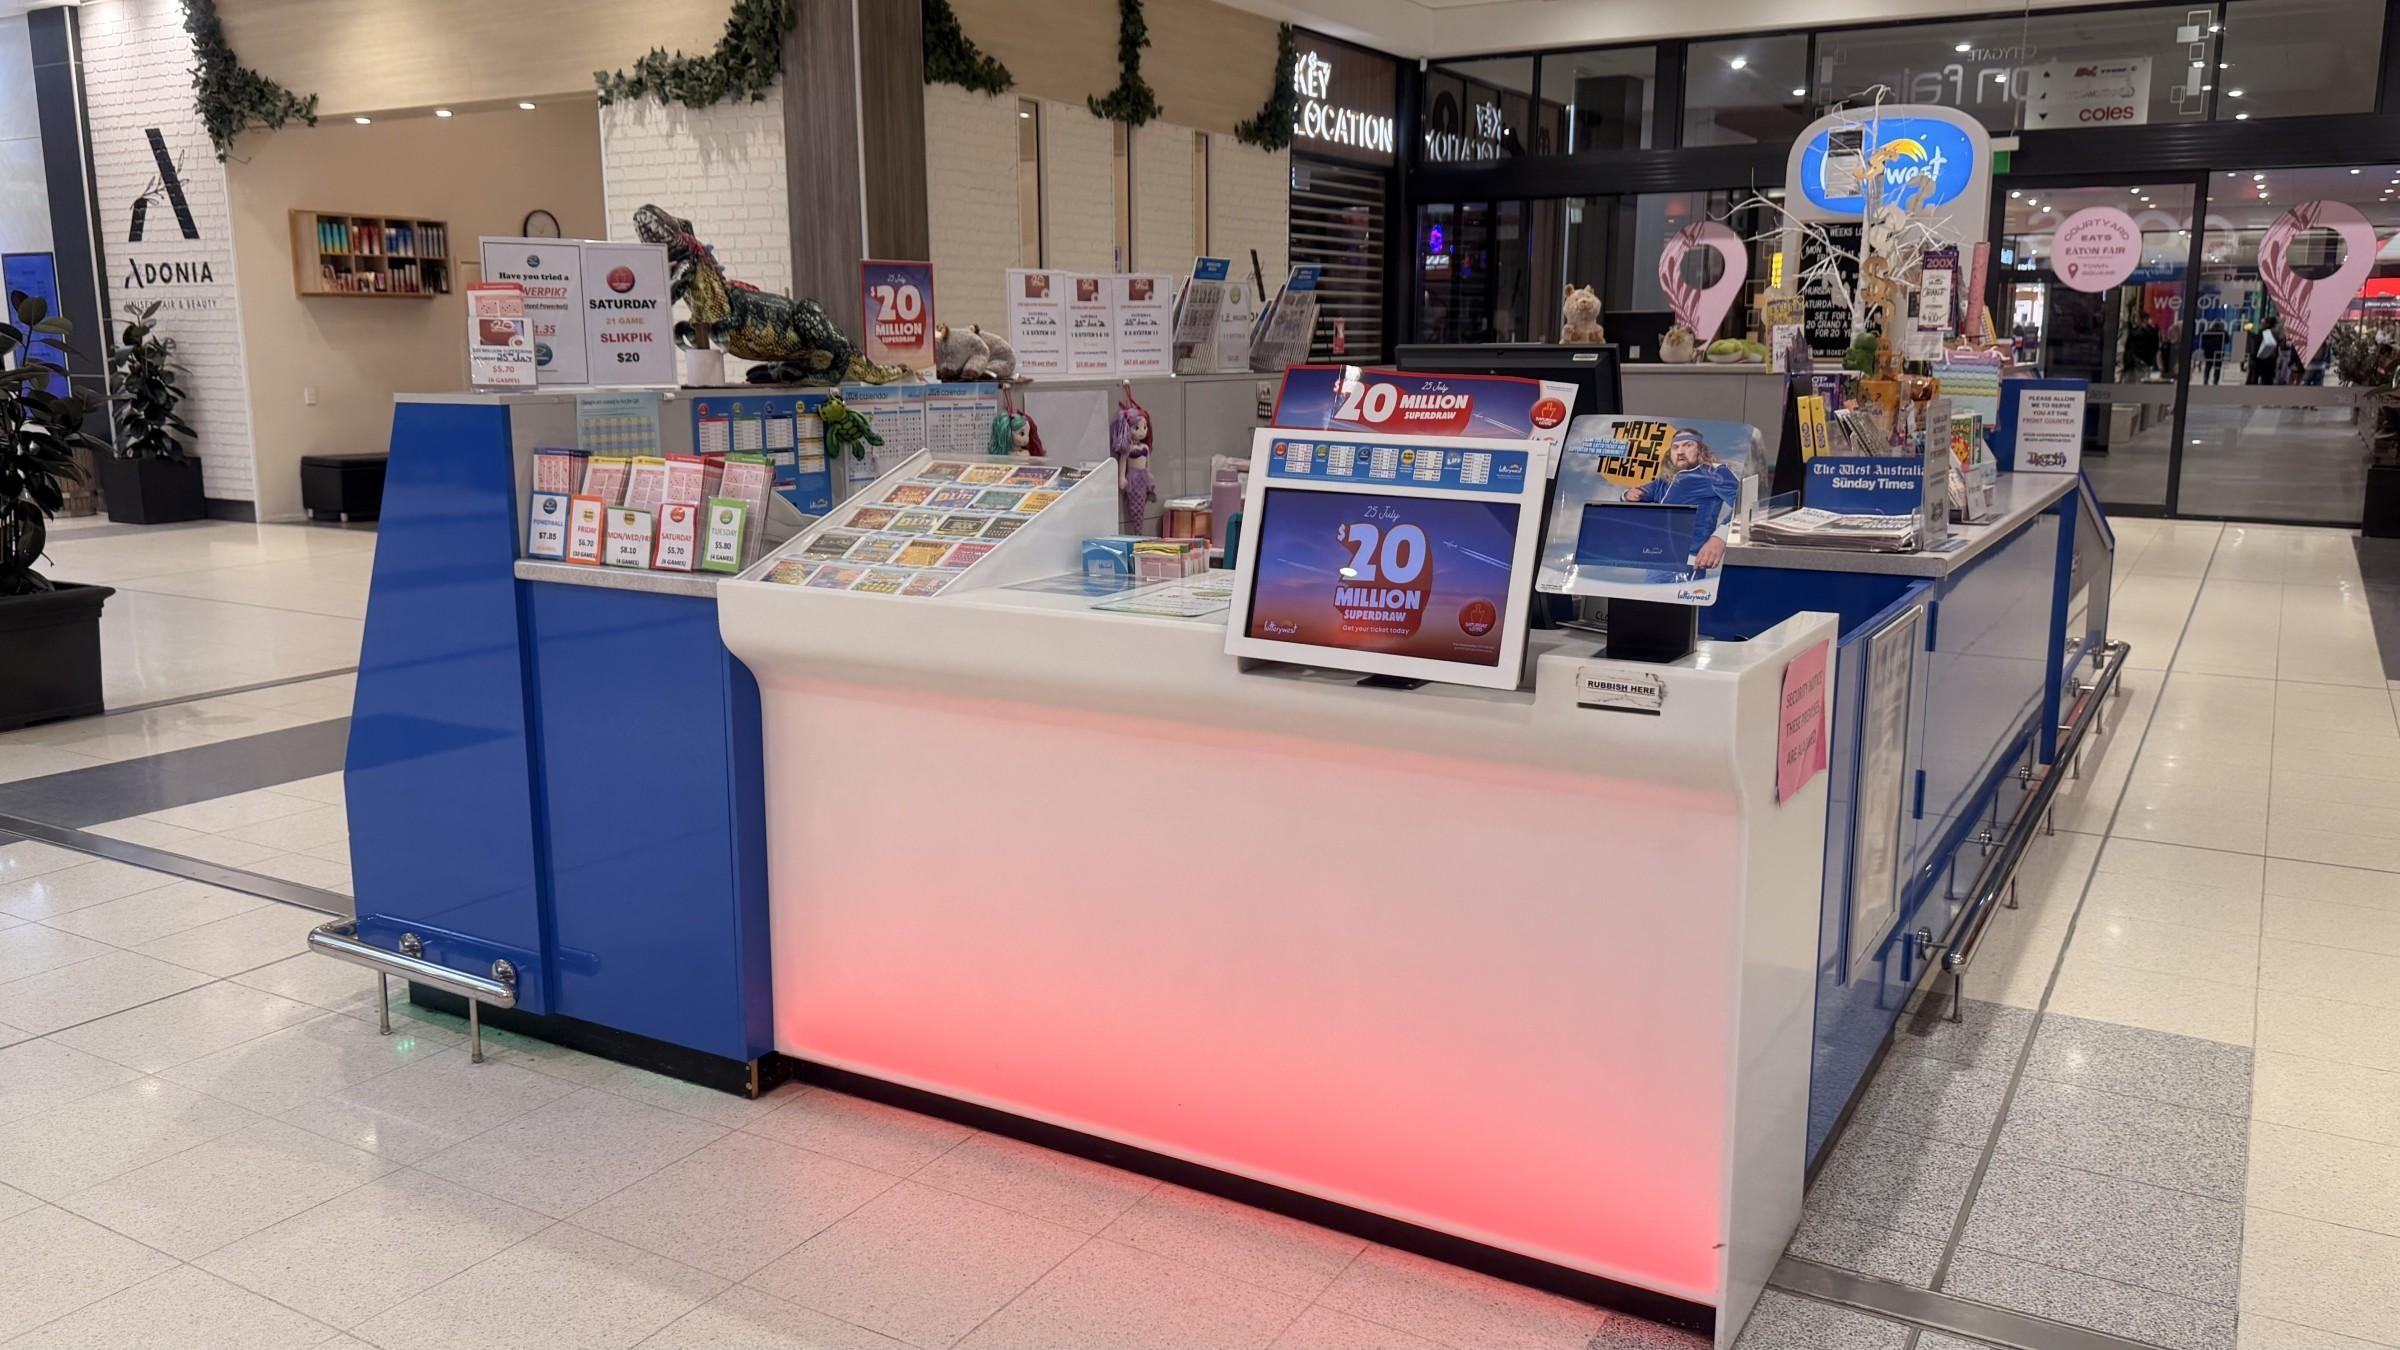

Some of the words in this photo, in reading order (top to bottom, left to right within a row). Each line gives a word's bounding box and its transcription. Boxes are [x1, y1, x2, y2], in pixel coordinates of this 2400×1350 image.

[1294, 52, 1332, 99] KEY
[2079, 105, 2134, 122] coles
[1294, 100, 1393, 153] LOCATION
[1830, 227, 1853, 237] WEEKS
[2064, 219, 2130, 241] COURTYARD
[2065, 247, 2099, 255] EATON
[1926, 258, 1954, 268] 200X
[125, 258, 213, 289] ADONIA
[499, 272, 521, 281] Have
[523, 273, 539, 282] you
[540, 272, 562, 281] tried
[589, 300, 657, 310] SATURDAY
[870, 285, 922, 320] $20
[1804, 300, 1835, 309] ATURDAY
[618, 317, 644, 325] GAME
[1815, 311, 1830, 320] SET
[1832, 311, 1847, 320] FOR
[535, 325, 556, 334] 1.35
[876, 322, 922, 336] MILLION
[1806, 320, 1816, 329] 20
[1817, 320, 1840, 329] GRAND
[600, 333, 653, 343] SLIKPIK
[1815, 329, 1829, 338] FOR
[1830, 329, 1839, 337] 20
[881, 336, 916, 344] SUPERDRAW
[617, 353, 640, 363] $20
[1421, 381, 1432, 391] 25
[1433, 381, 1449, 393] July
[1333, 379, 1398, 423] $20
[1399, 395, 1469, 410] MILLION
[1404, 410, 1457, 420] SUPERDRAW
[1611, 421, 1667, 441] THAT'S
[1627, 439, 1662, 461] THE
[1597, 455, 1660, 481] TICKET!
[1813, 464, 1835, 475] The
[1839, 464, 1870, 475] West
[1873, 464, 1925, 476] Australia
[1832, 477, 1876, 491] Sunday
[1877, 478, 1915, 490] Times
[1364, 506, 1377, 518] 25
[1379, 506, 1401, 522] July
[577, 526, 597, 534] FRIDAY
[712, 527, 737, 537] TUESDAY
[538, 532, 557, 541] $7.85
[661, 533, 692, 542] SATURDAY
[620, 546, 637, 554] $8.10
[667, 546, 684, 555] $5.70
[1336, 523, 1427, 584] $20
[1335, 587, 1421, 610] MILLION
[1677, 589, 1713, 602] lotterywest
[1344, 610, 1407, 622] SUPERDRAW
[1264, 619, 1298, 634] lotterywest
[1342, 624, 1355, 632] Get
[1355, 626, 1370, 635] your
[1370, 625, 1390, 633] ticket
[1390, 626, 1410, 636] today
[1588, 680, 1628, 692] RUBBISH
[1630, 685, 1656, 695] HERE
[1786, 683, 1808, 709] SECURITY
[1786, 715, 1801, 737] THESE
[1786, 746, 1797, 767] ARE
